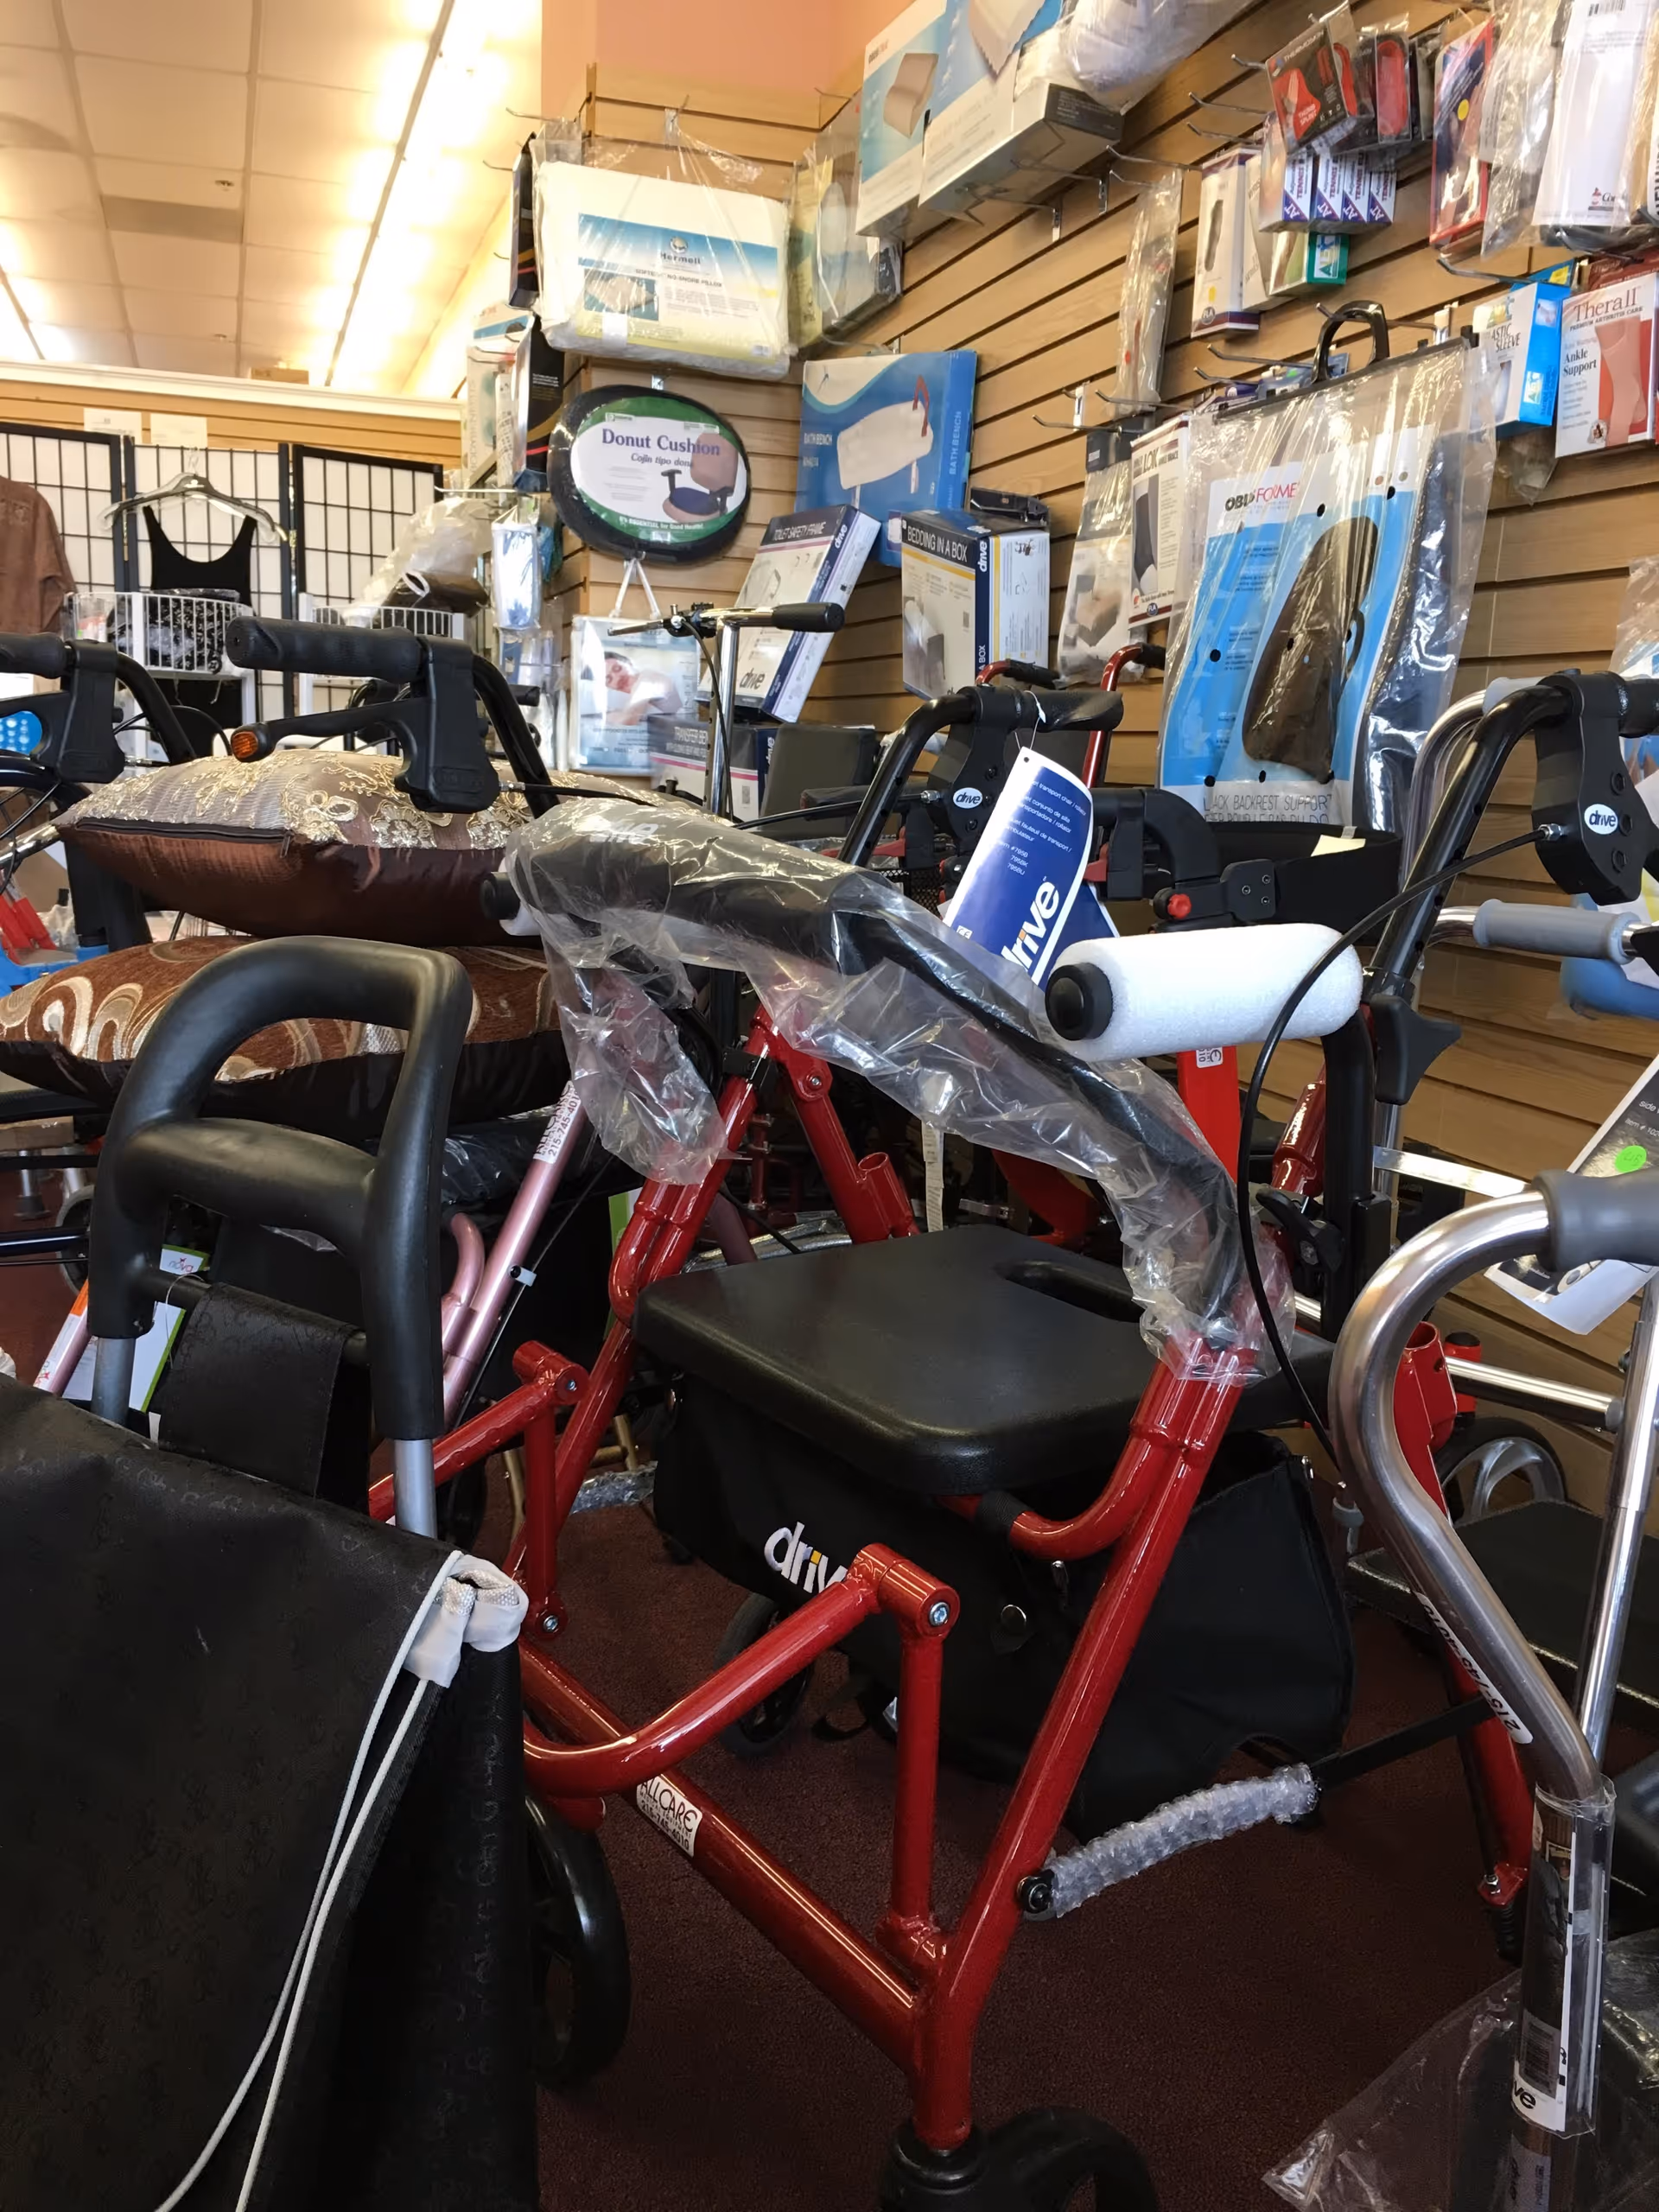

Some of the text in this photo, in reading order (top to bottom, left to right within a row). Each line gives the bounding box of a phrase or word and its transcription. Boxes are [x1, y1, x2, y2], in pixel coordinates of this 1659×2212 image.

[1574, 287, 1637, 322] Therall
[1626, 306, 1643, 316] CARE
[1491, 323, 1512, 340] ASTIC
[1496, 332, 1521, 353] SLEEVE
[1565, 348, 1588, 364] Ankle
[1563, 359, 1598, 377] Support
[602, 429, 720, 455] Donut Cushion
[835, 524, 848, 549] drive
[907, 526, 968, 563] BEDDING IN A BOX
[977, 541, 988, 572] drive
[739, 668, 765, 690] drive
[956, 790, 981, 806] drive
[1039, 783, 1062, 798] transport
[1061, 795, 1072, 805] chair
[1234, 794, 1280, 810] BACKREST
[1284, 793, 1332, 811] SUPPORT
[1032, 799, 1053, 814] conjunto
[1588, 810, 1617, 827] drive
[1021, 822, 1040, 836] fauteuil
[1047, 836, 1069, 851] transport
[1639, 1101, 1656, 1112] side
[1625, 1118, 1640, 1128] item
[764, 1521, 848, 1593] driv
